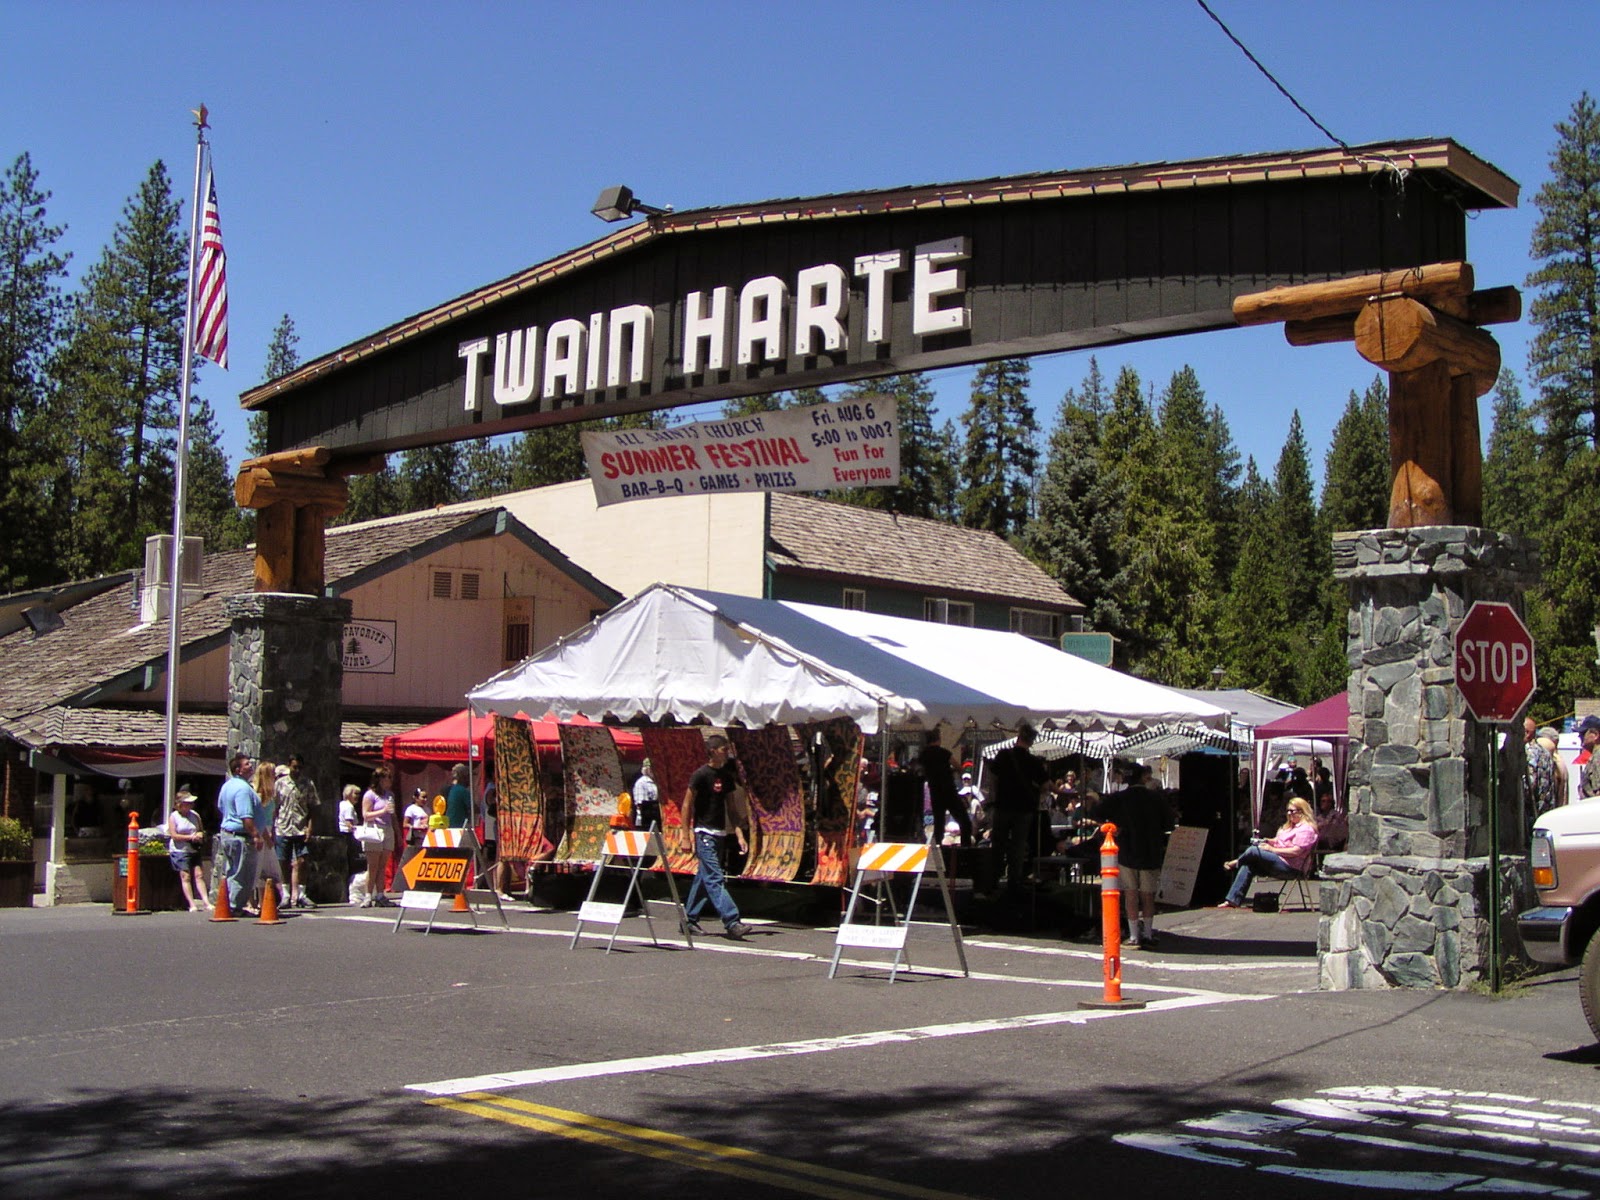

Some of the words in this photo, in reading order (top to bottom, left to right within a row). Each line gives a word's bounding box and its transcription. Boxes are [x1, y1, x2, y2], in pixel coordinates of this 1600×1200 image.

[458, 304, 654, 411] TWAIN
[683, 236, 971, 374] HARTE
[812, 409, 835, 426] Fri.
[837, 404, 865, 422] AUG.
[865, 403, 875, 420] 6
[615, 432, 644, 446] ALL
[646, 425, 699, 441] SAINTS
[704, 417, 765, 438] CHURCH
[811, 428, 840, 447] 5:00
[845, 428, 858, 442] to
[601, 444, 701, 479] SUMMER
[703, 437, 810, 469] FESTIVAL
[833, 447, 859, 462] Fun
[863, 443, 884, 459] For
[621, 477, 684, 498] BAR-B-Q
[700, 473, 740, 490] GAMES
[754, 472, 797, 488] PRIZES
[832, 466, 892, 485] Everyone
[1460, 639, 1528, 684] STOP
[417, 862, 463, 879] DETOUR
